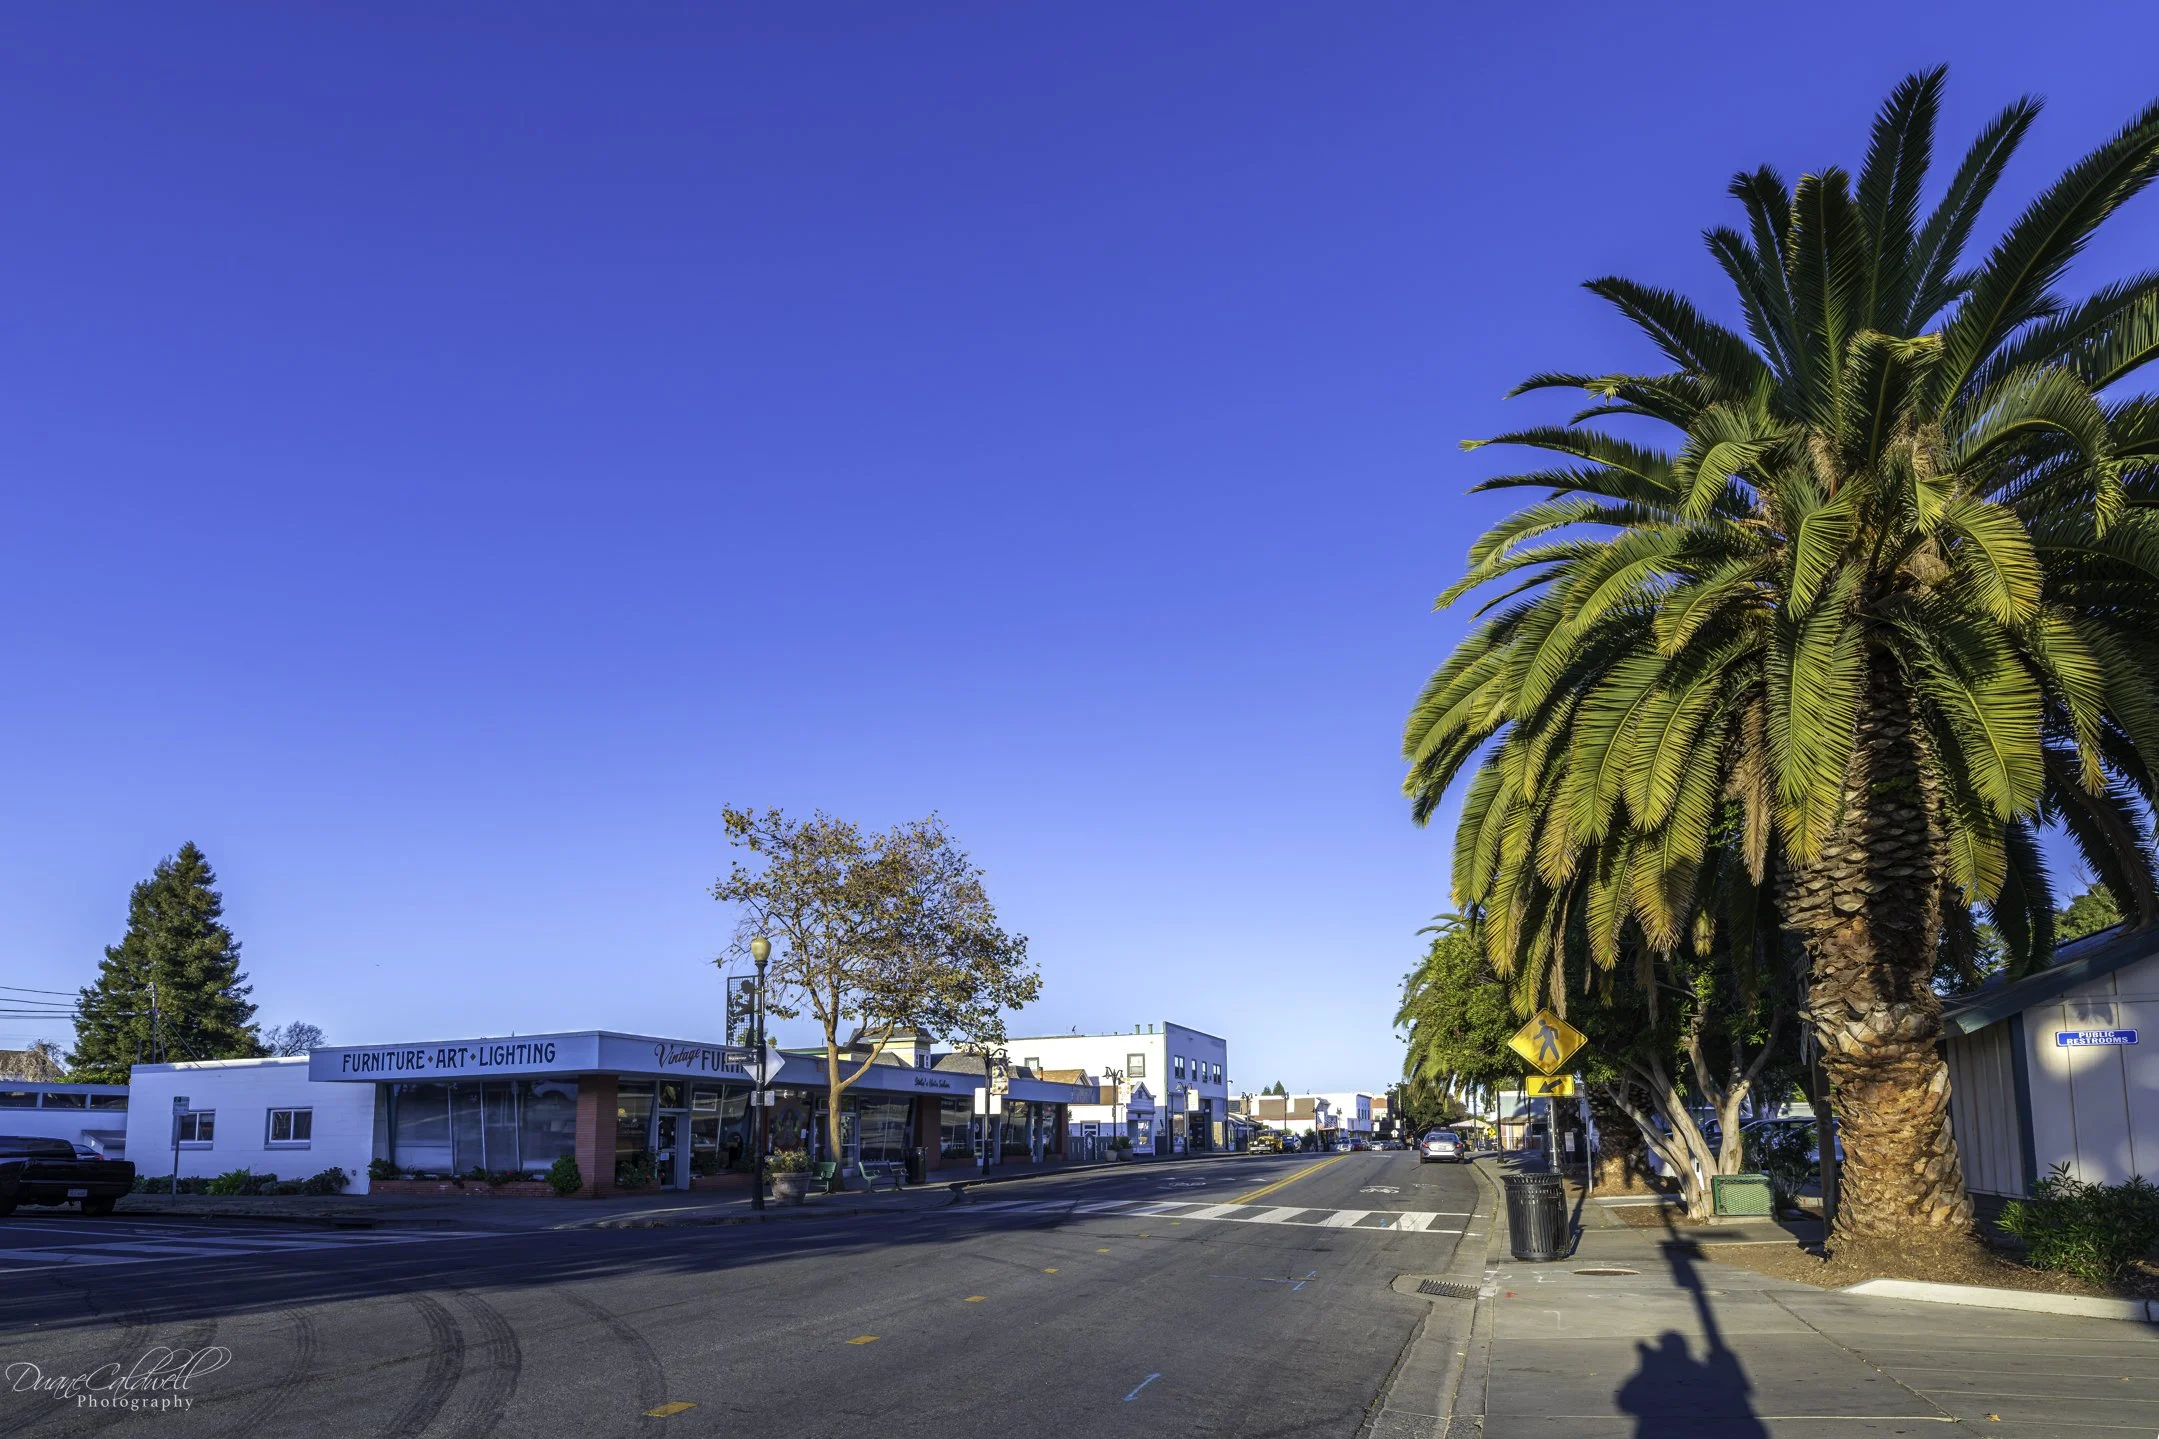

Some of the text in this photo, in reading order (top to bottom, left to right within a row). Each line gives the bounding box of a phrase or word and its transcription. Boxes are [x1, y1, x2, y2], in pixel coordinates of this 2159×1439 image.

[2066, 1036, 2128, 1045] RESTROOMS
[342, 1042, 556, 1072] FURNITURE ART LIGHTING
[654, 1043, 701, 1068] Vintage
